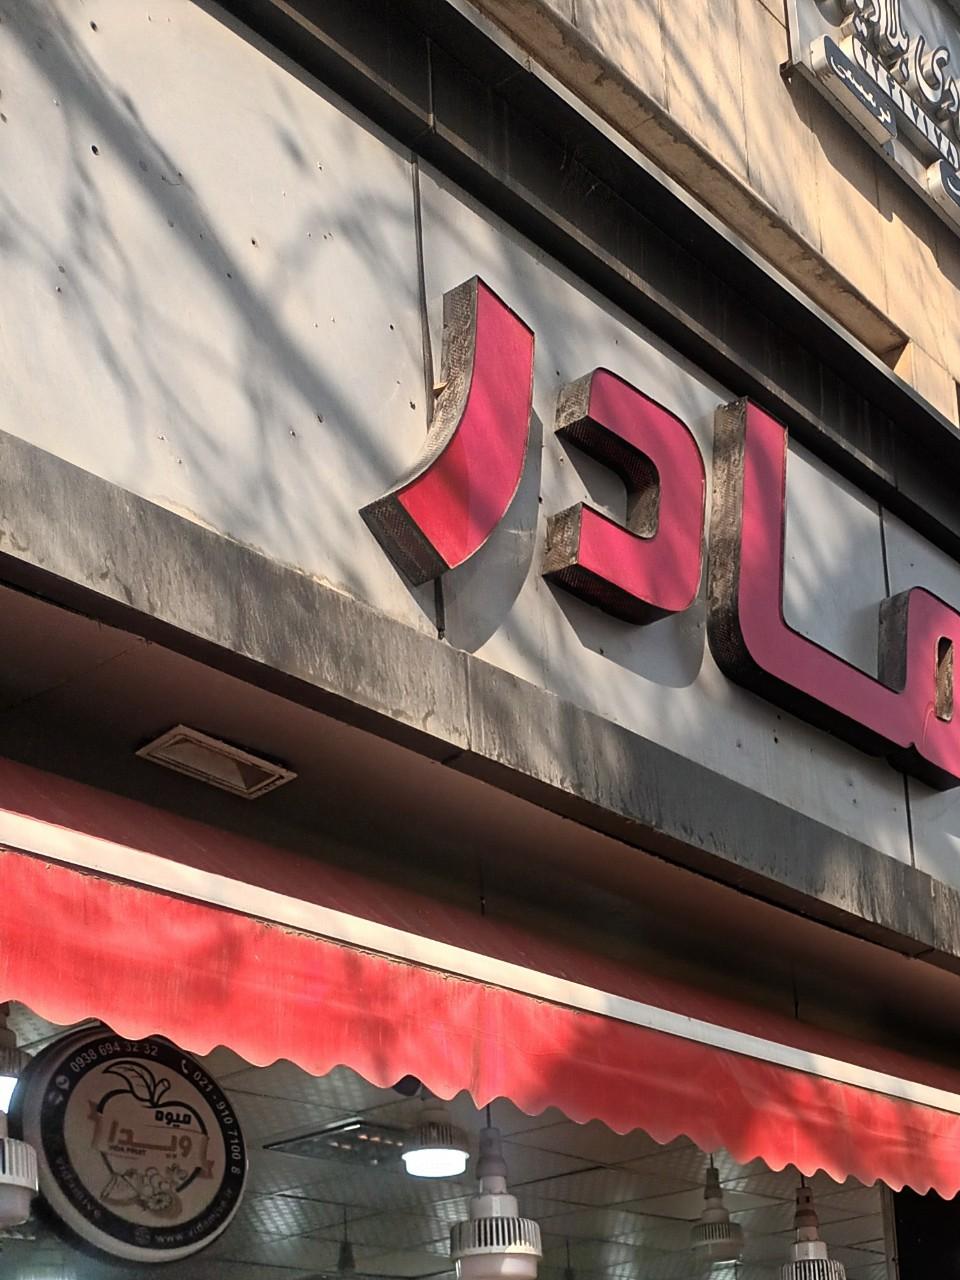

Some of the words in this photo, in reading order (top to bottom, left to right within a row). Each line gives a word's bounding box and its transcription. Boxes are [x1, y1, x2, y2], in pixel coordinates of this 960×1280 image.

[69, 1049, 97, 1074] 0938
[98, 1041, 121, 1057] 694
[193, 1071, 213, 1092] 021
[215, 1101, 233, 1125] 910
[155, 1110, 192, 1127] میوه
[108, 1120, 193, 1159] ویدا
